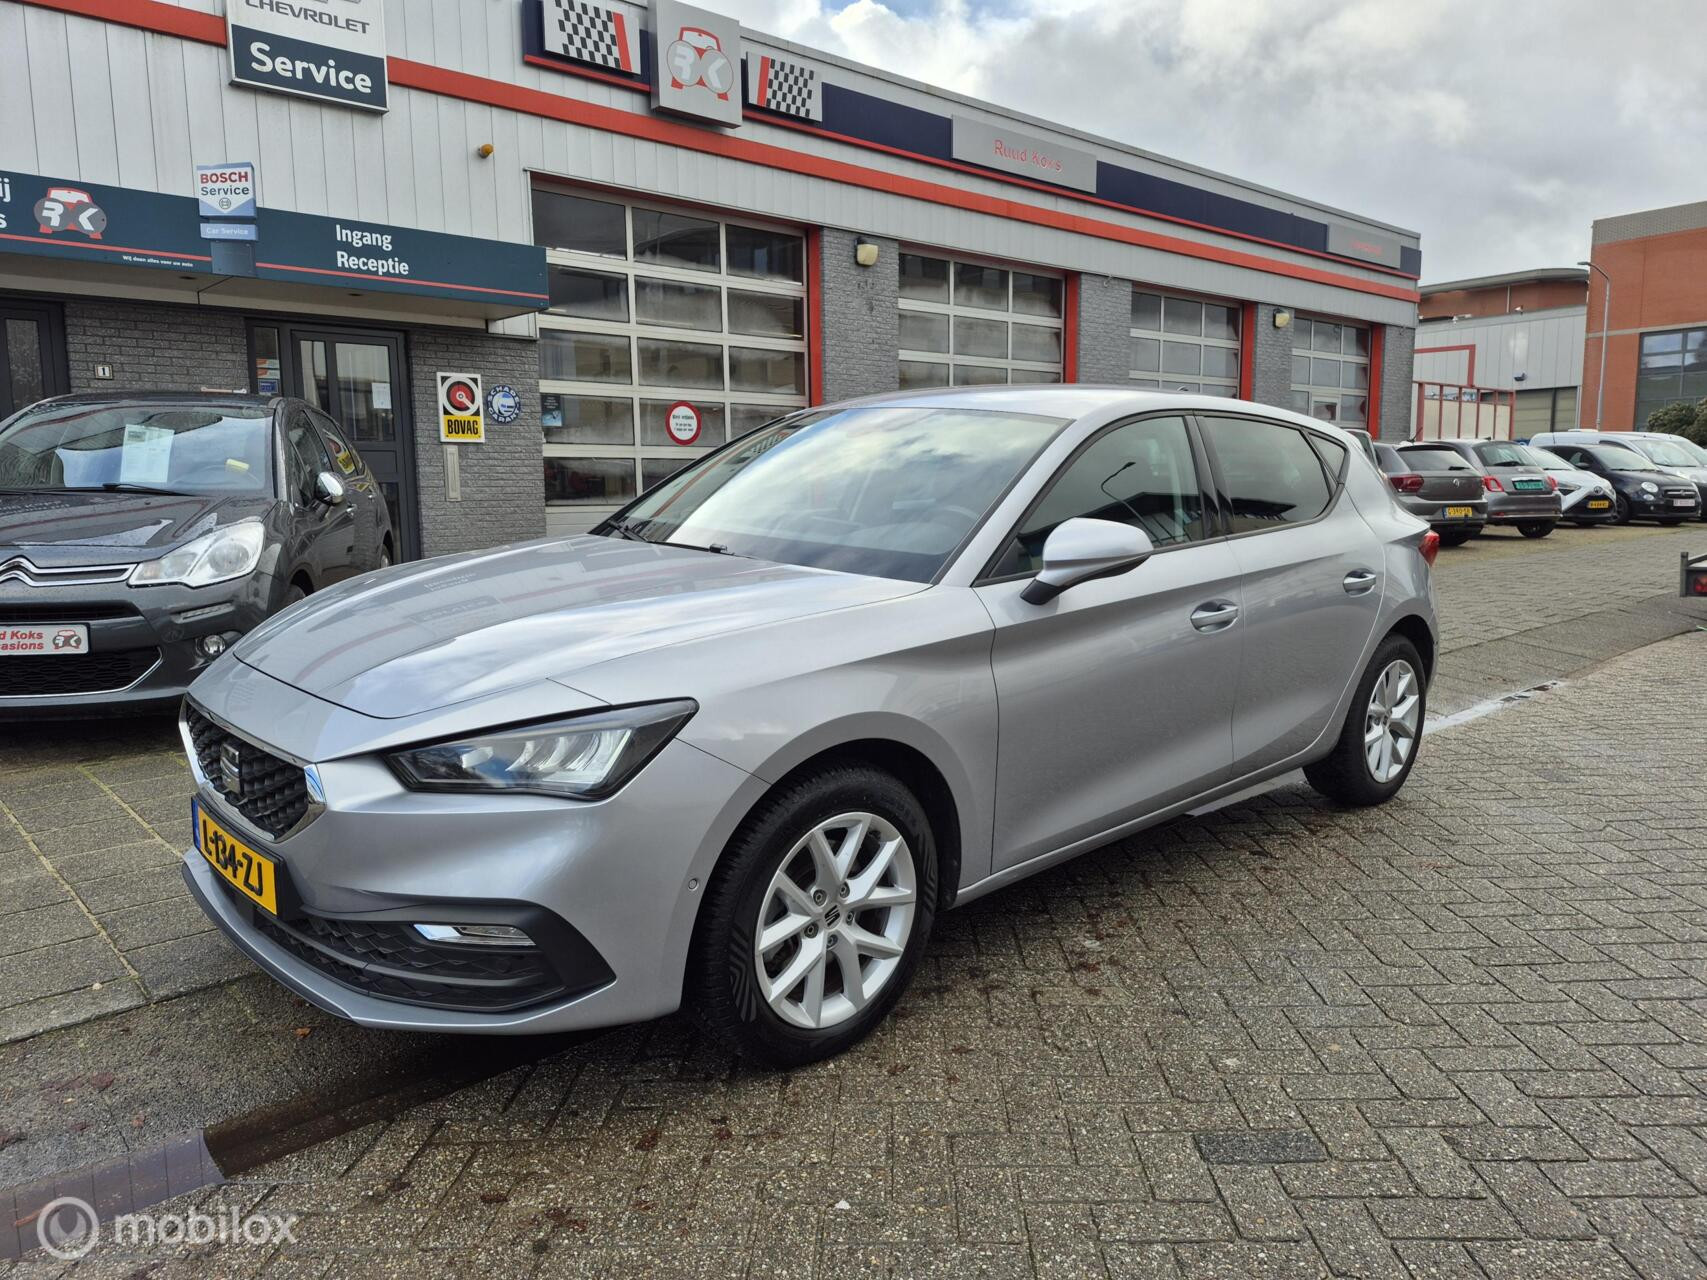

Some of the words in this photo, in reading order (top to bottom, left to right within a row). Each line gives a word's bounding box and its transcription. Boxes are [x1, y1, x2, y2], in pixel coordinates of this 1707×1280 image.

[250, 41, 372, 94] Service
[994, 139, 1027, 162] Ruud
[200, 171, 249, 184] BOSCH
[201, 185, 250, 196] Service
[222, 227, 249, 235] Service
[335, 224, 393, 251] Ingang
[336, 250, 409, 276] Receptie
[101, 367, 106, 376] 1
[487, 386, 521, 402] SCHADE
[447, 419, 479, 435] BOVAG
[10, 630, 44, 640] Koks
[202, 819, 264, 897] L-134-ZJ
